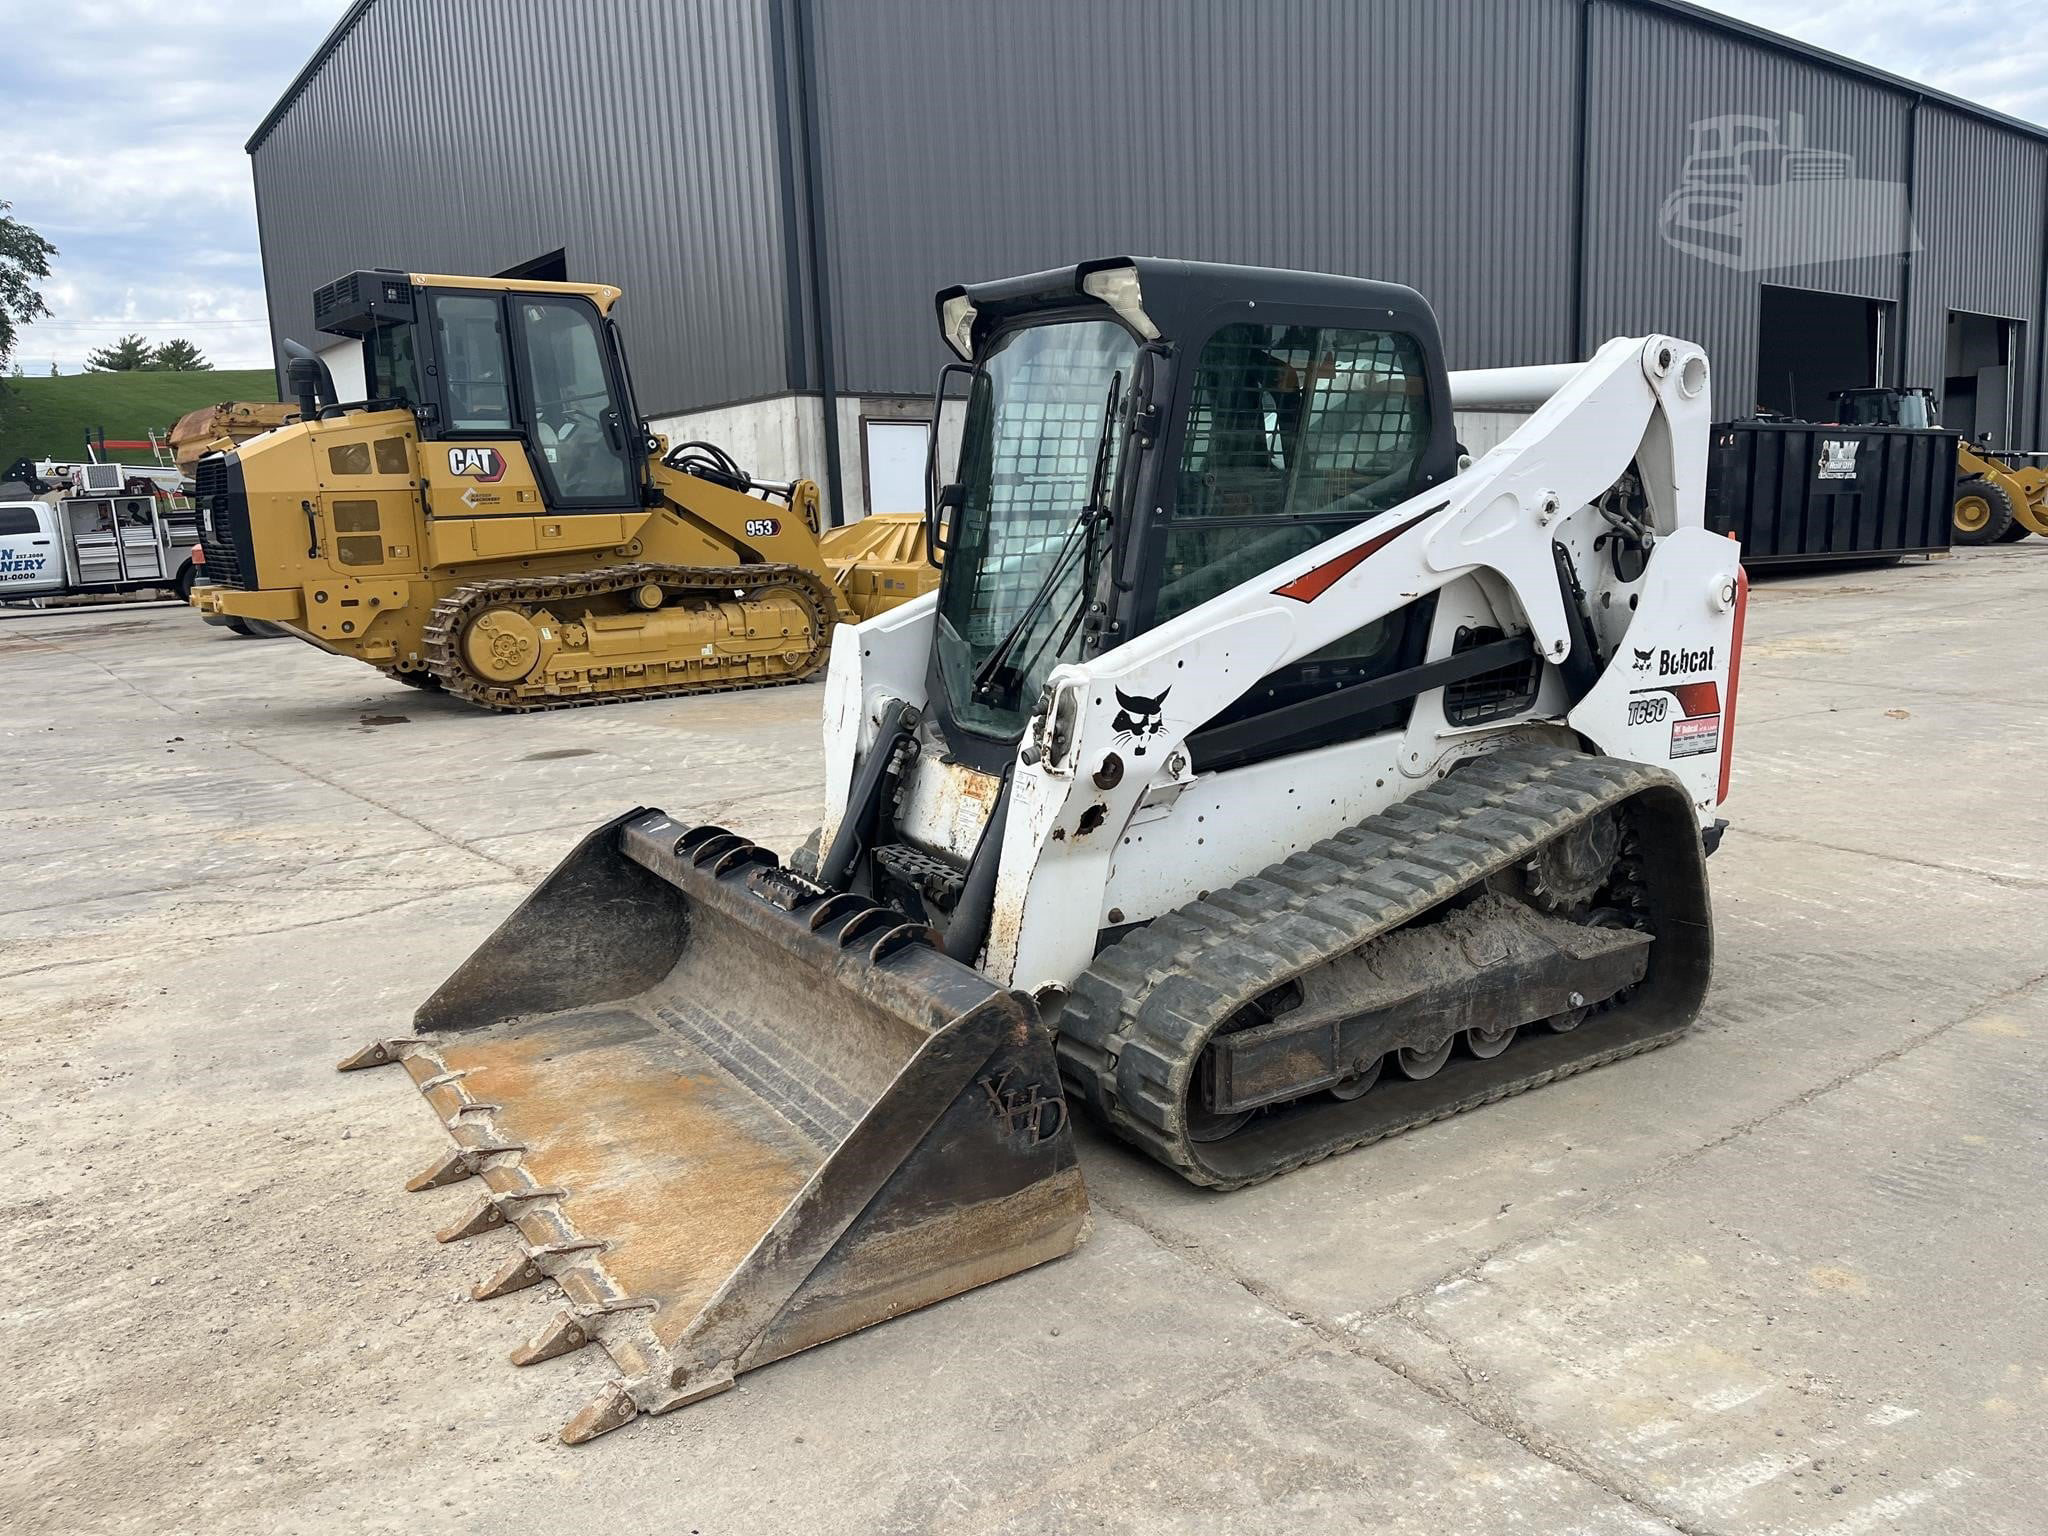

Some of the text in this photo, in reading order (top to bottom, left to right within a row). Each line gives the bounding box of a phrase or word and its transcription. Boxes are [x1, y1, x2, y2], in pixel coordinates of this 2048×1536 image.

[448, 448, 492, 475] CAT
[746, 519, 773, 536] 953
[1659, 646, 1714, 676] Bobcat
[1627, 697, 1668, 726] T650
